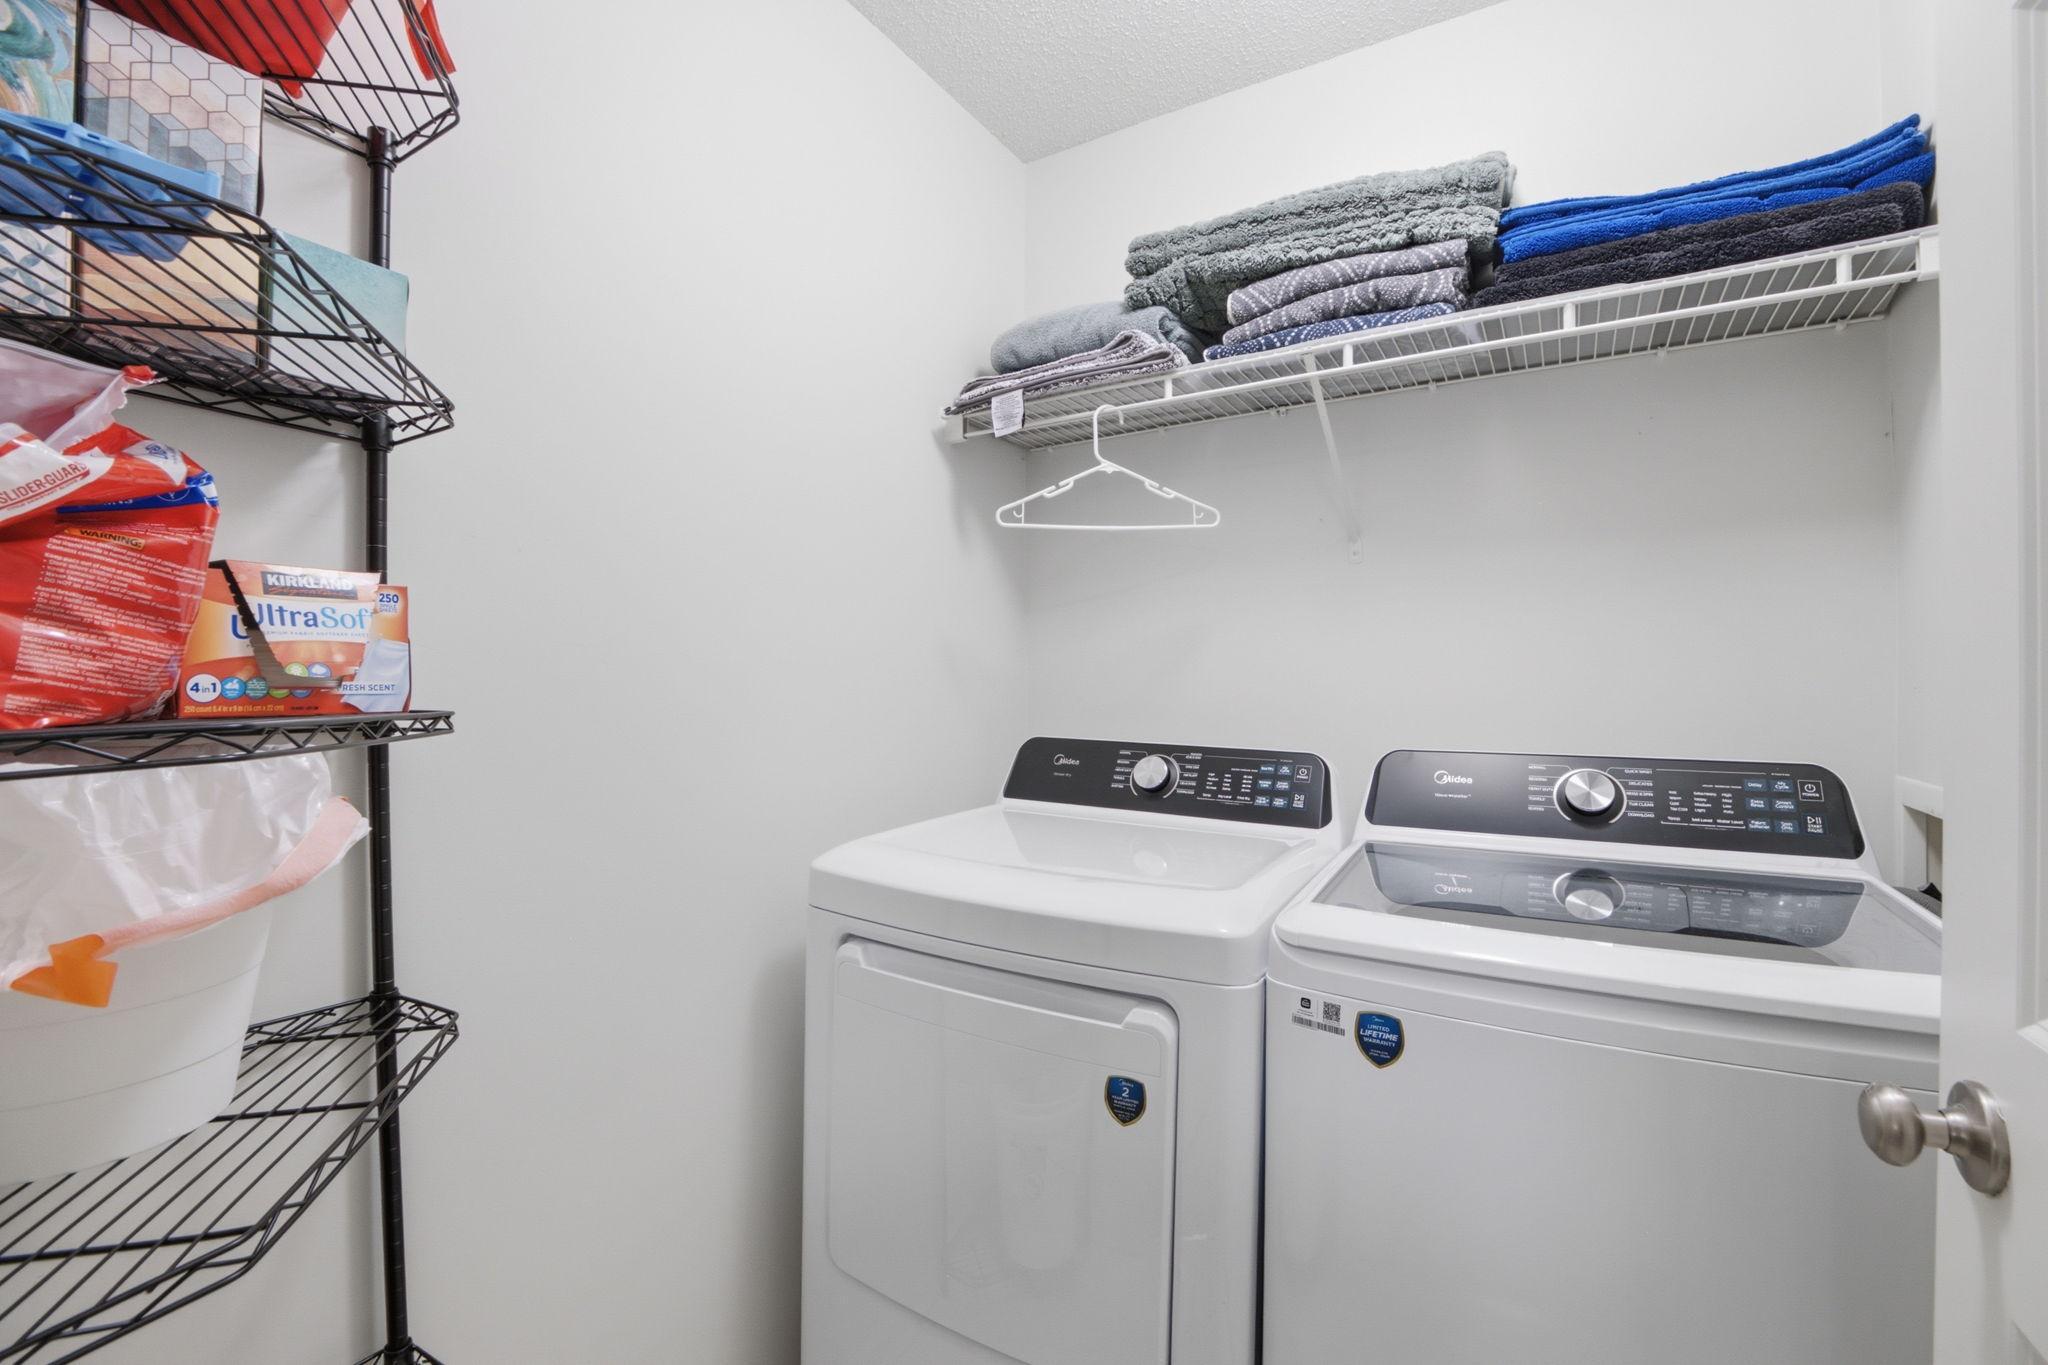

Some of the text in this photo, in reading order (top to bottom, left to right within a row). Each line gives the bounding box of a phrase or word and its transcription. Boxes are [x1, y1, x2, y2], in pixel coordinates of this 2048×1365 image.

[80, 529, 142, 549] WARNING:
[266, 573, 354, 590] KIRKLAND
[379, 593, 399, 604] 250
[190, 682, 217, 693] 4 in 1
[1053, 754, 1080, 766] Midea
[1434, 770, 1473, 785] Midea
[1360, 1029, 1399, 1041] LIFETIME
[1363, 1037, 1396, 1047] WARRANTY
[1122, 1087, 1130, 1097] 2
